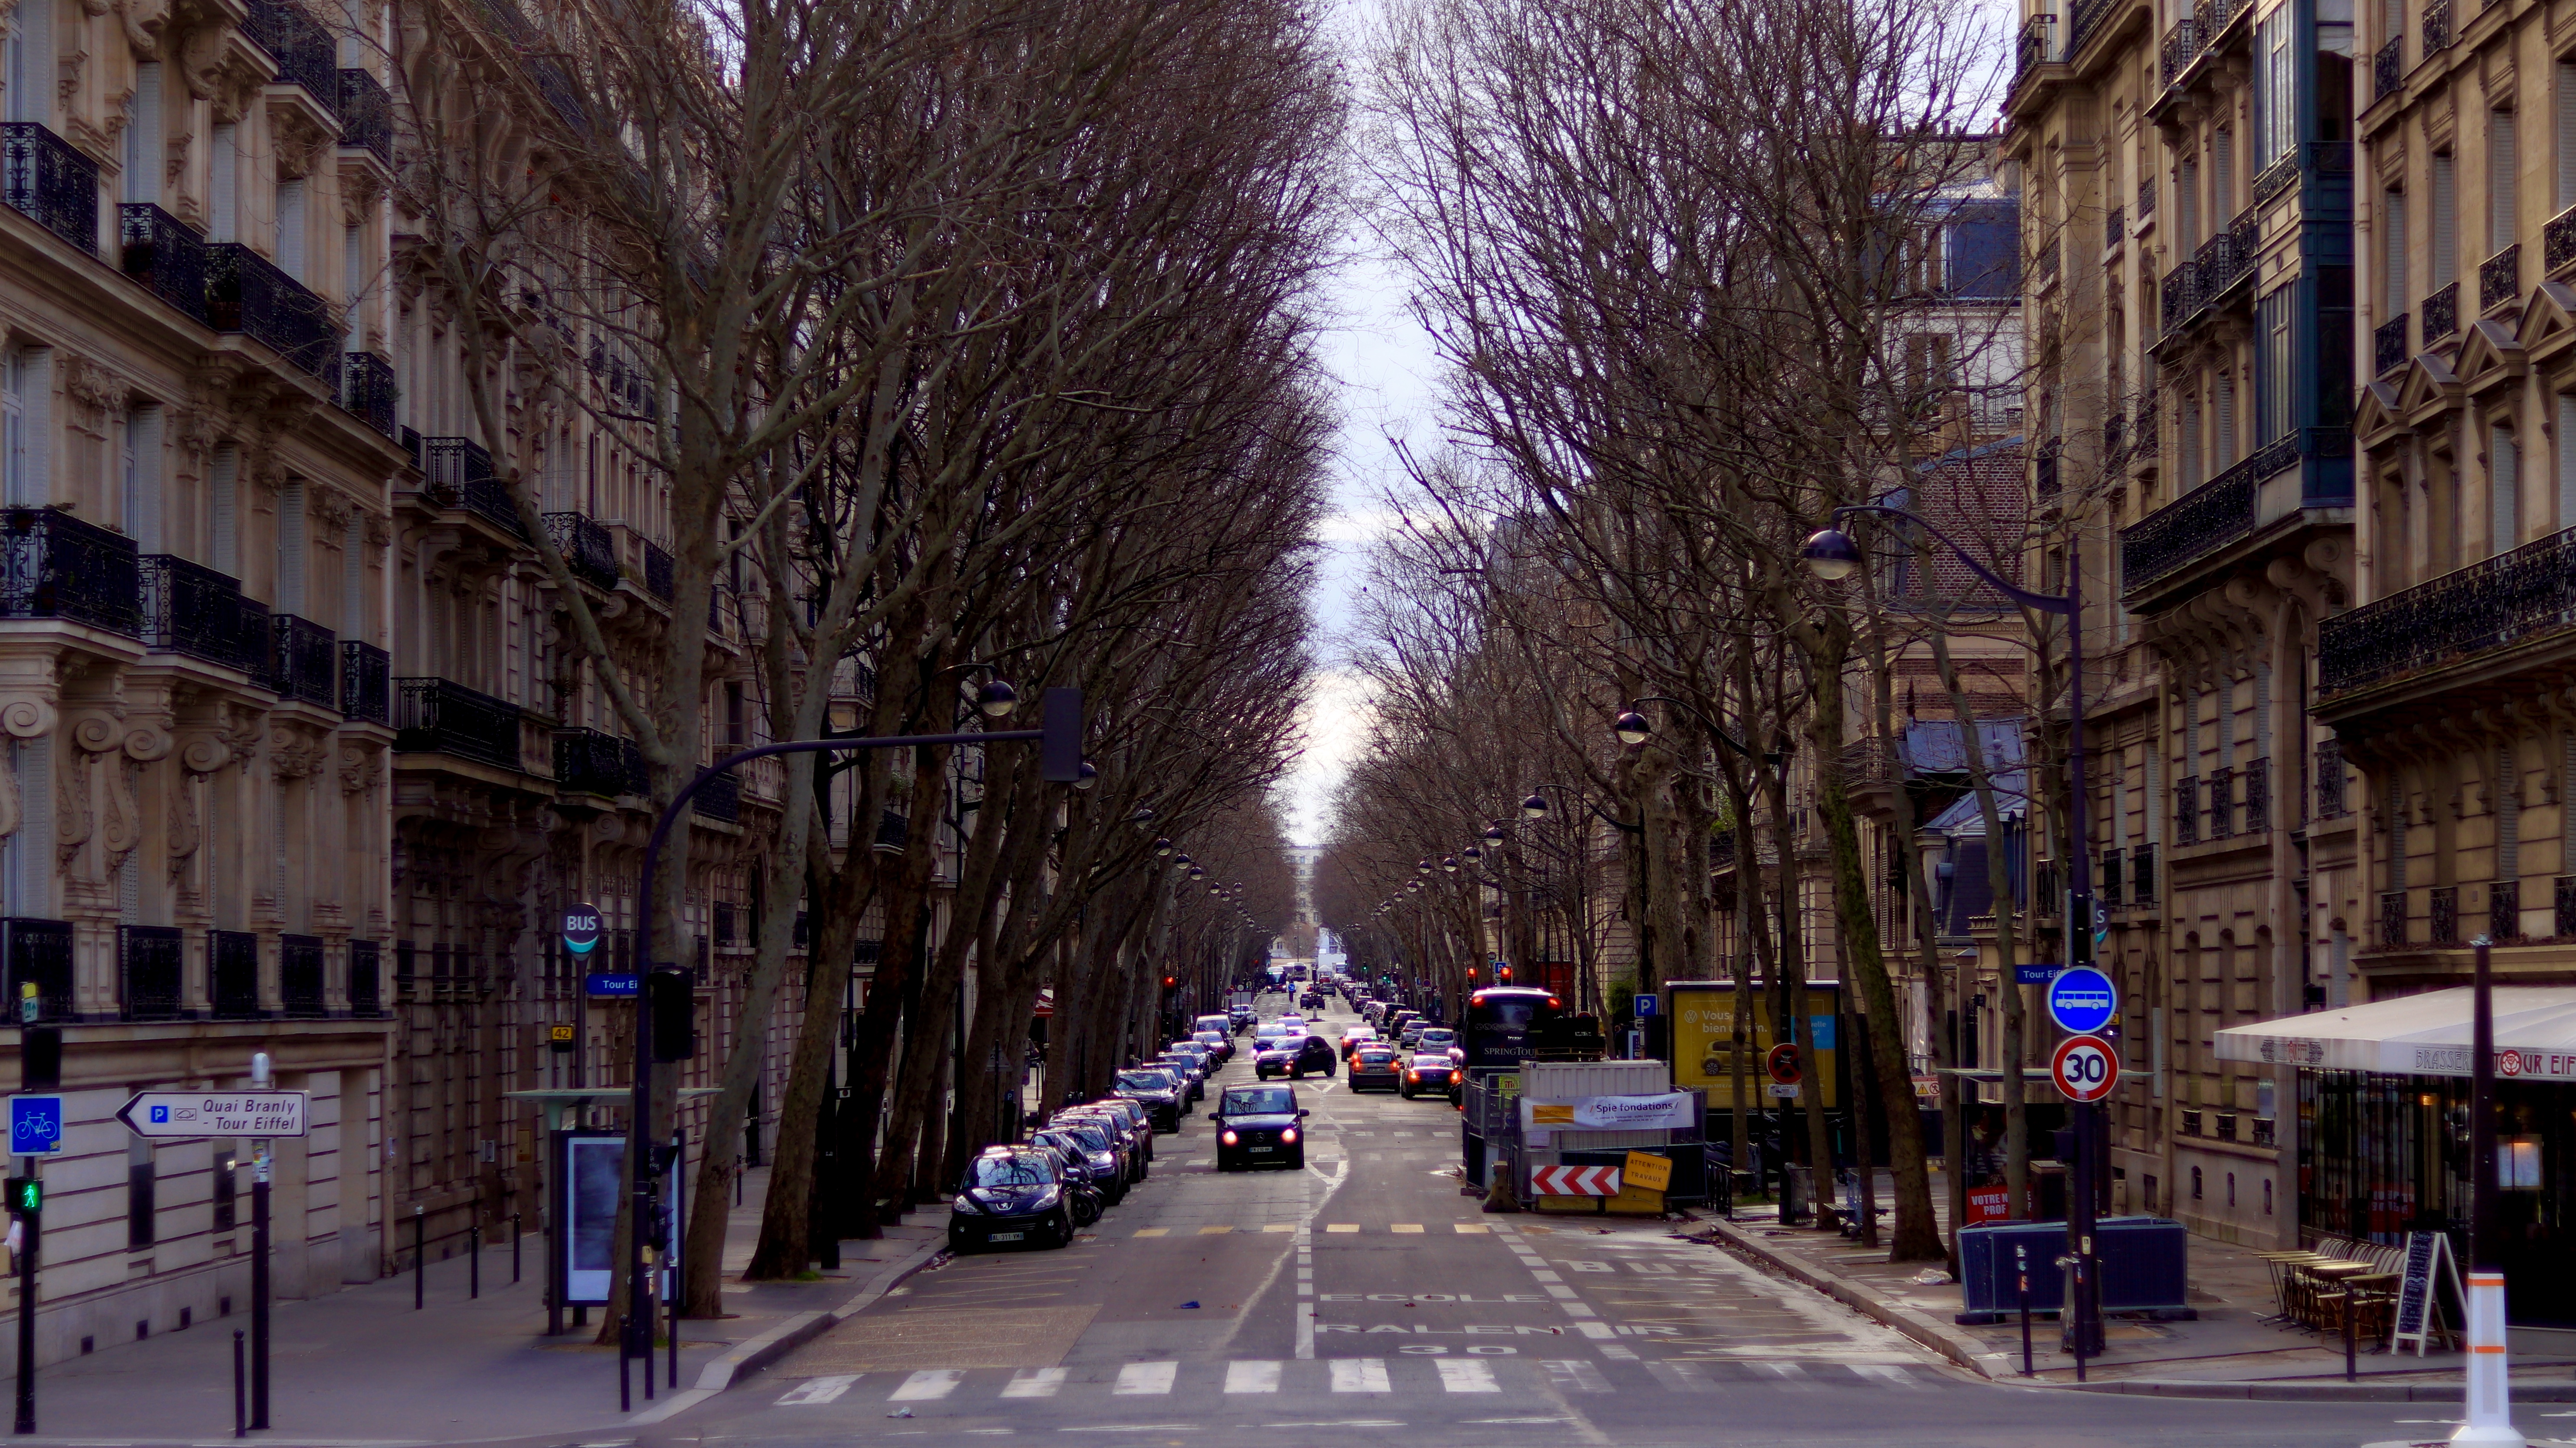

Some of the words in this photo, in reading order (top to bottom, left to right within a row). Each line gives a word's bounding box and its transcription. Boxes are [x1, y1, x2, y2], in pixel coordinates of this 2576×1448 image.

[567, 916, 596, 931] BUS
[2048, 970, 2063, 978] Eif
[603, 980, 625, 988] Tour
[1641, 999, 1651, 1013] P
[1702, 1011, 1729, 1020] Vous
[555, 1028, 569, 1038] 42
[1703, 1023, 1726, 1033] bien
[1485, 1047, 1534, 1056] SPRINGTOU
[2416, 1050, 2474, 1071] BRASSERI
[2550, 1055, 2576, 1075] EIF
[2065, 1054, 2105, 1083] 30
[203, 1099, 238, 1112] Quai
[245, 1099, 295, 1115] Branly
[1597, 1105, 1617, 1114] Spie
[1620, 1102, 1673, 1111] fondations
[155, 1109, 163, 1120] P
[215, 1117, 247, 1129] Tour
[254, 1117, 295, 1130] Eiffel
[1630, 1159, 1668, 1171] ATTENTION
[1631, 1172, 1662, 1183] TRAVAUX
[1972, 1194, 1999, 1205] VOTRE
[1399, 1346, 1517, 1354] 30
